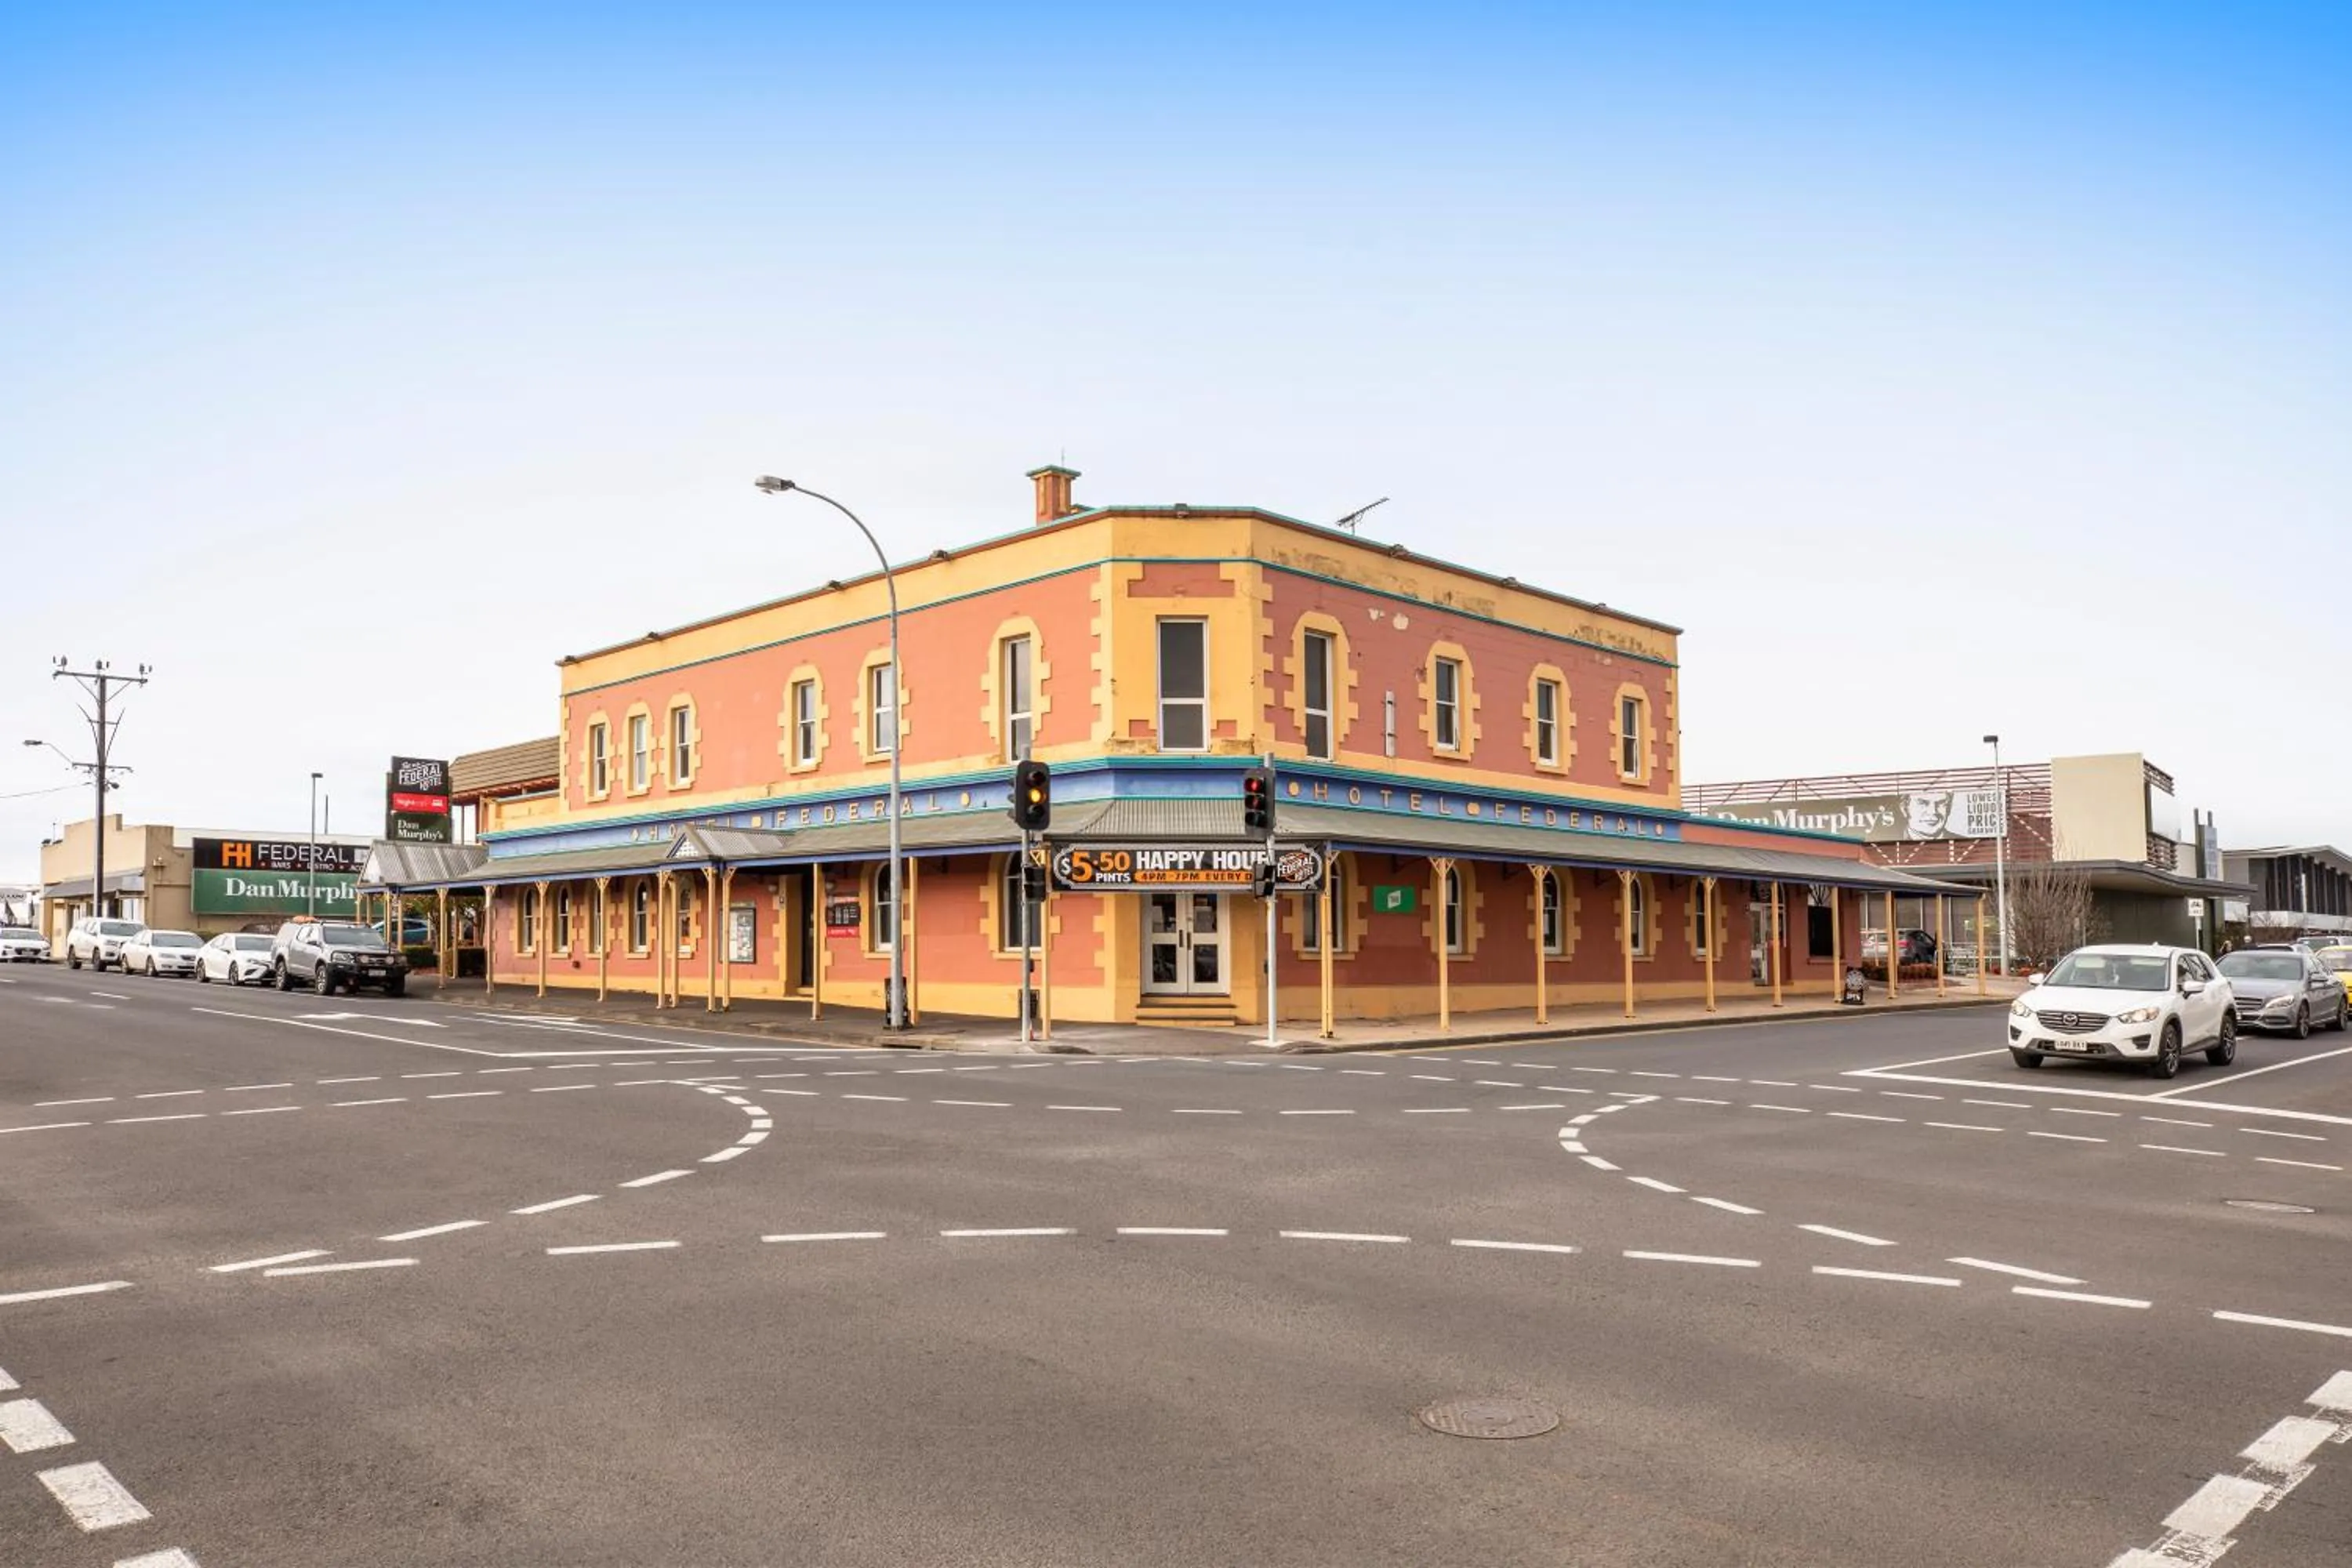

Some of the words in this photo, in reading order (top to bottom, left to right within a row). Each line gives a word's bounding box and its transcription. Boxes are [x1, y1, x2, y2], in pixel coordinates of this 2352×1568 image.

[399, 763, 441, 785] FEDERAL
[777, 793, 942, 827] FEDERAL
[1314, 782, 1451, 815] HOTEL
[1495, 803, 1646, 834] FEDERAL
[397, 819, 419, 829] Dan
[1773, 805, 1895, 835] Murphy's
[397, 829, 444, 841] Murphy's
[258, 844, 349, 863] FEDERAL
[1137, 851, 1205, 870] HAPPY
[1095, 872, 1131, 882] PINTS
[1205, 872, 1242, 880] EVERY
[226, 877, 274, 897] Dan
[278, 879, 360, 904] Murph
